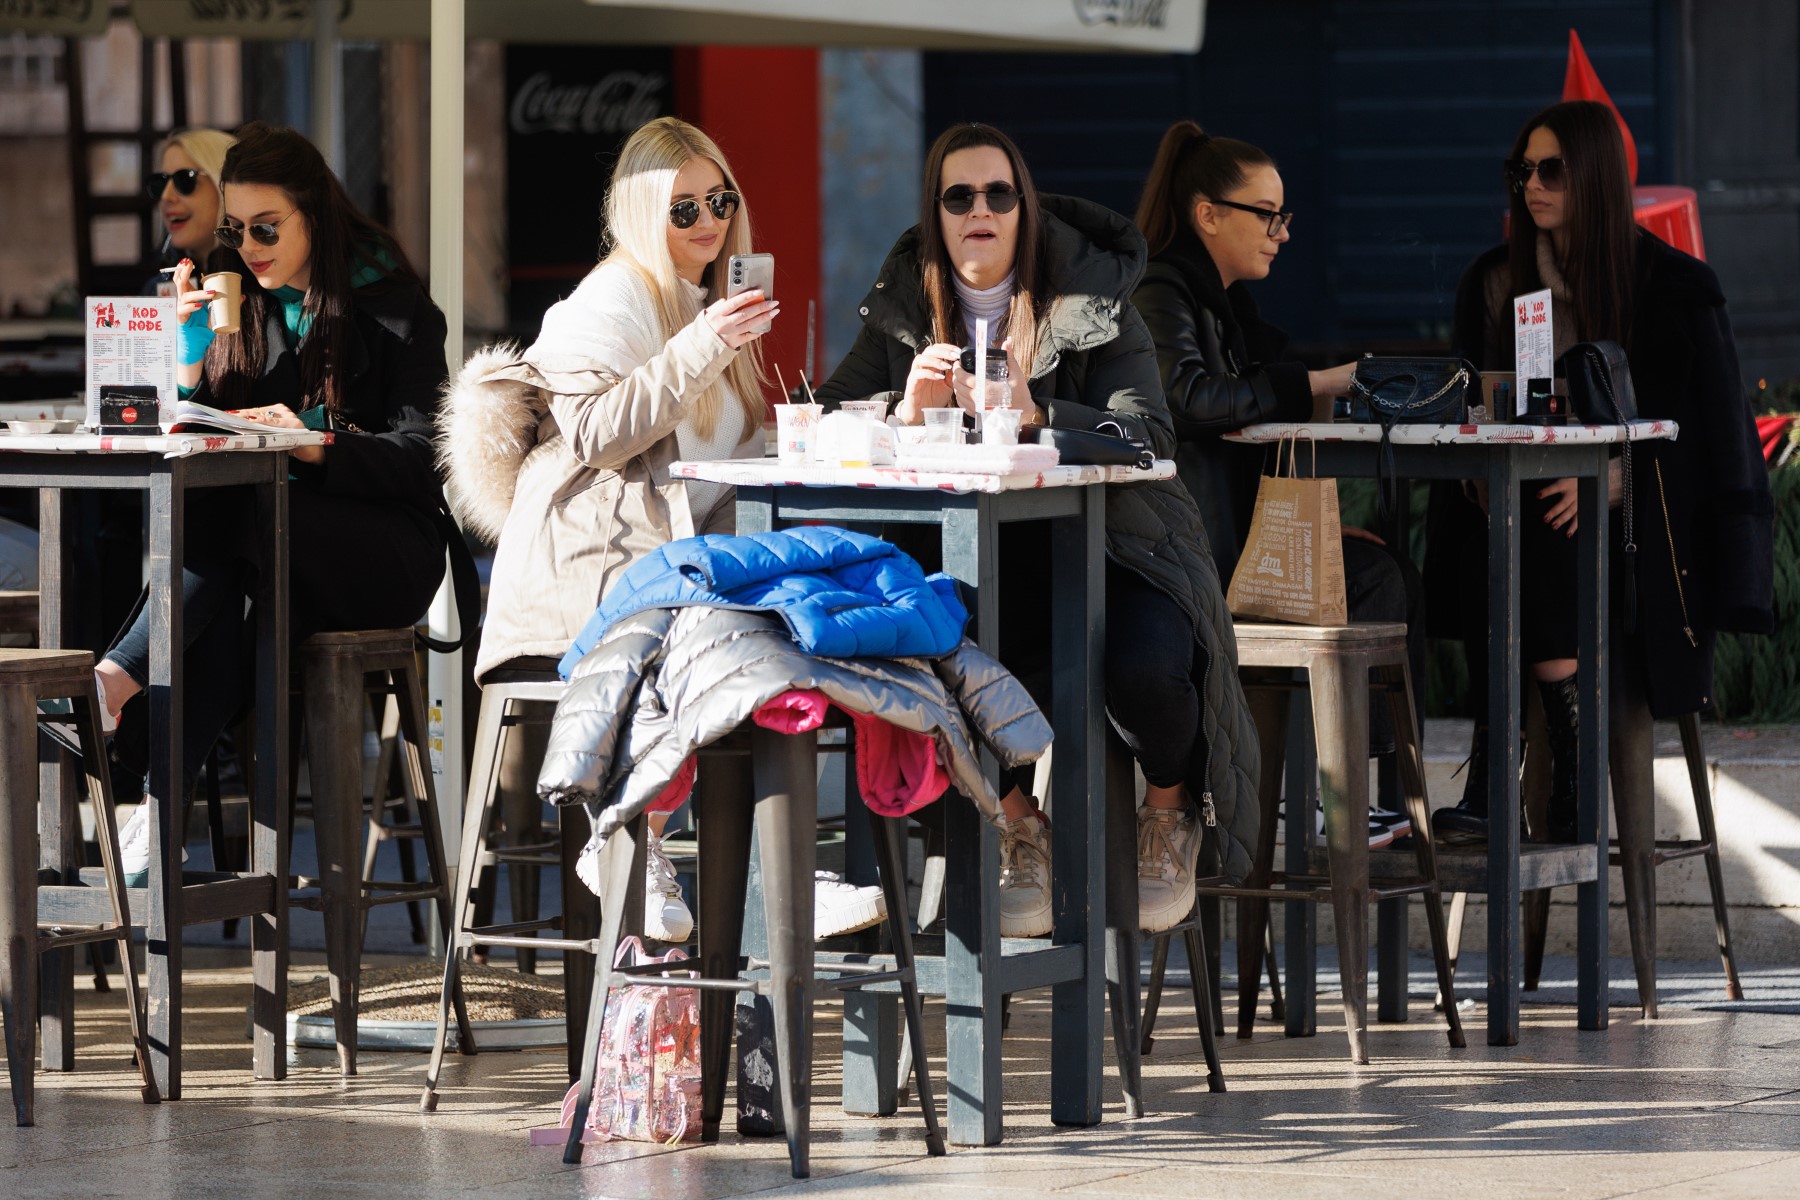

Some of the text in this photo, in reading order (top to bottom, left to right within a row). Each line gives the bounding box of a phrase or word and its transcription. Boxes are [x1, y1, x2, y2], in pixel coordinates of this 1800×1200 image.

[132, 307, 158, 318] KOD
[1533, 301, 1544, 313] KOD
[1531, 312, 1546, 325] RODE
[128, 320, 162, 331] RODE
[1261, 552, 1280, 568] dm
